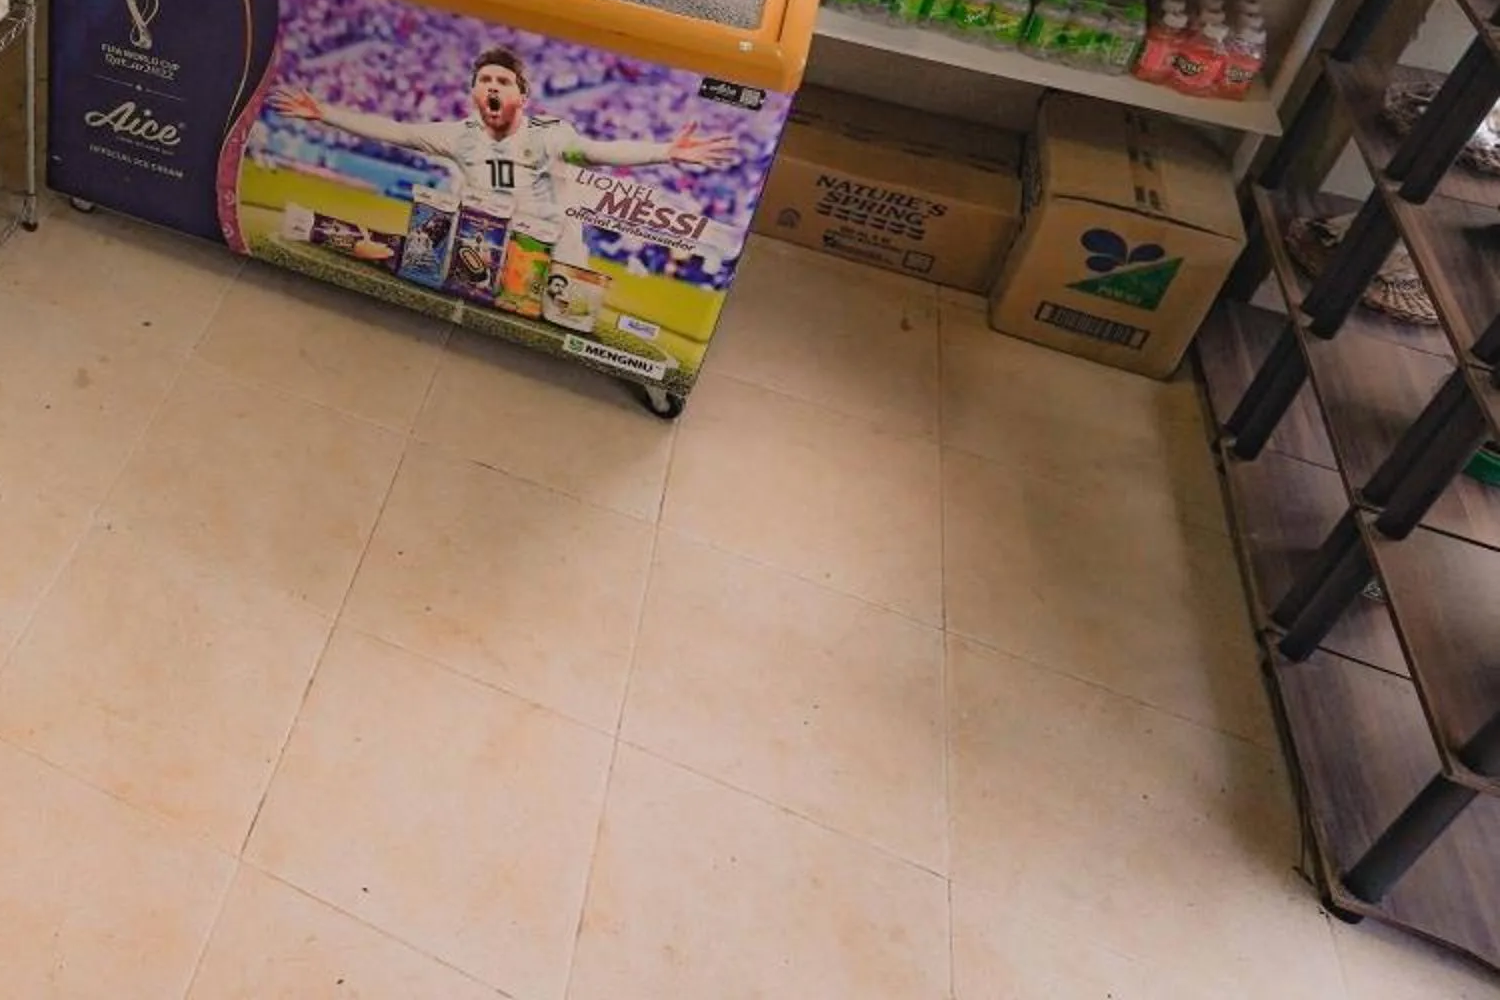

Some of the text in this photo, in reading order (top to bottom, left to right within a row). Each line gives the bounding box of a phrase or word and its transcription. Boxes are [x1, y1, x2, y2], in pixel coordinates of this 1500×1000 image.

[84, 101, 182, 146] Aice
[485, 159, 516, 189] 10
[575, 168, 654, 202] LIONEL
[815, 174, 949, 218] NATURE'S
[822, 189, 927, 227] SPRING
[565, 205, 611, 231] Official
[590, 191, 709, 241] MESSI
[585, 343, 654, 374] MENGNIU
